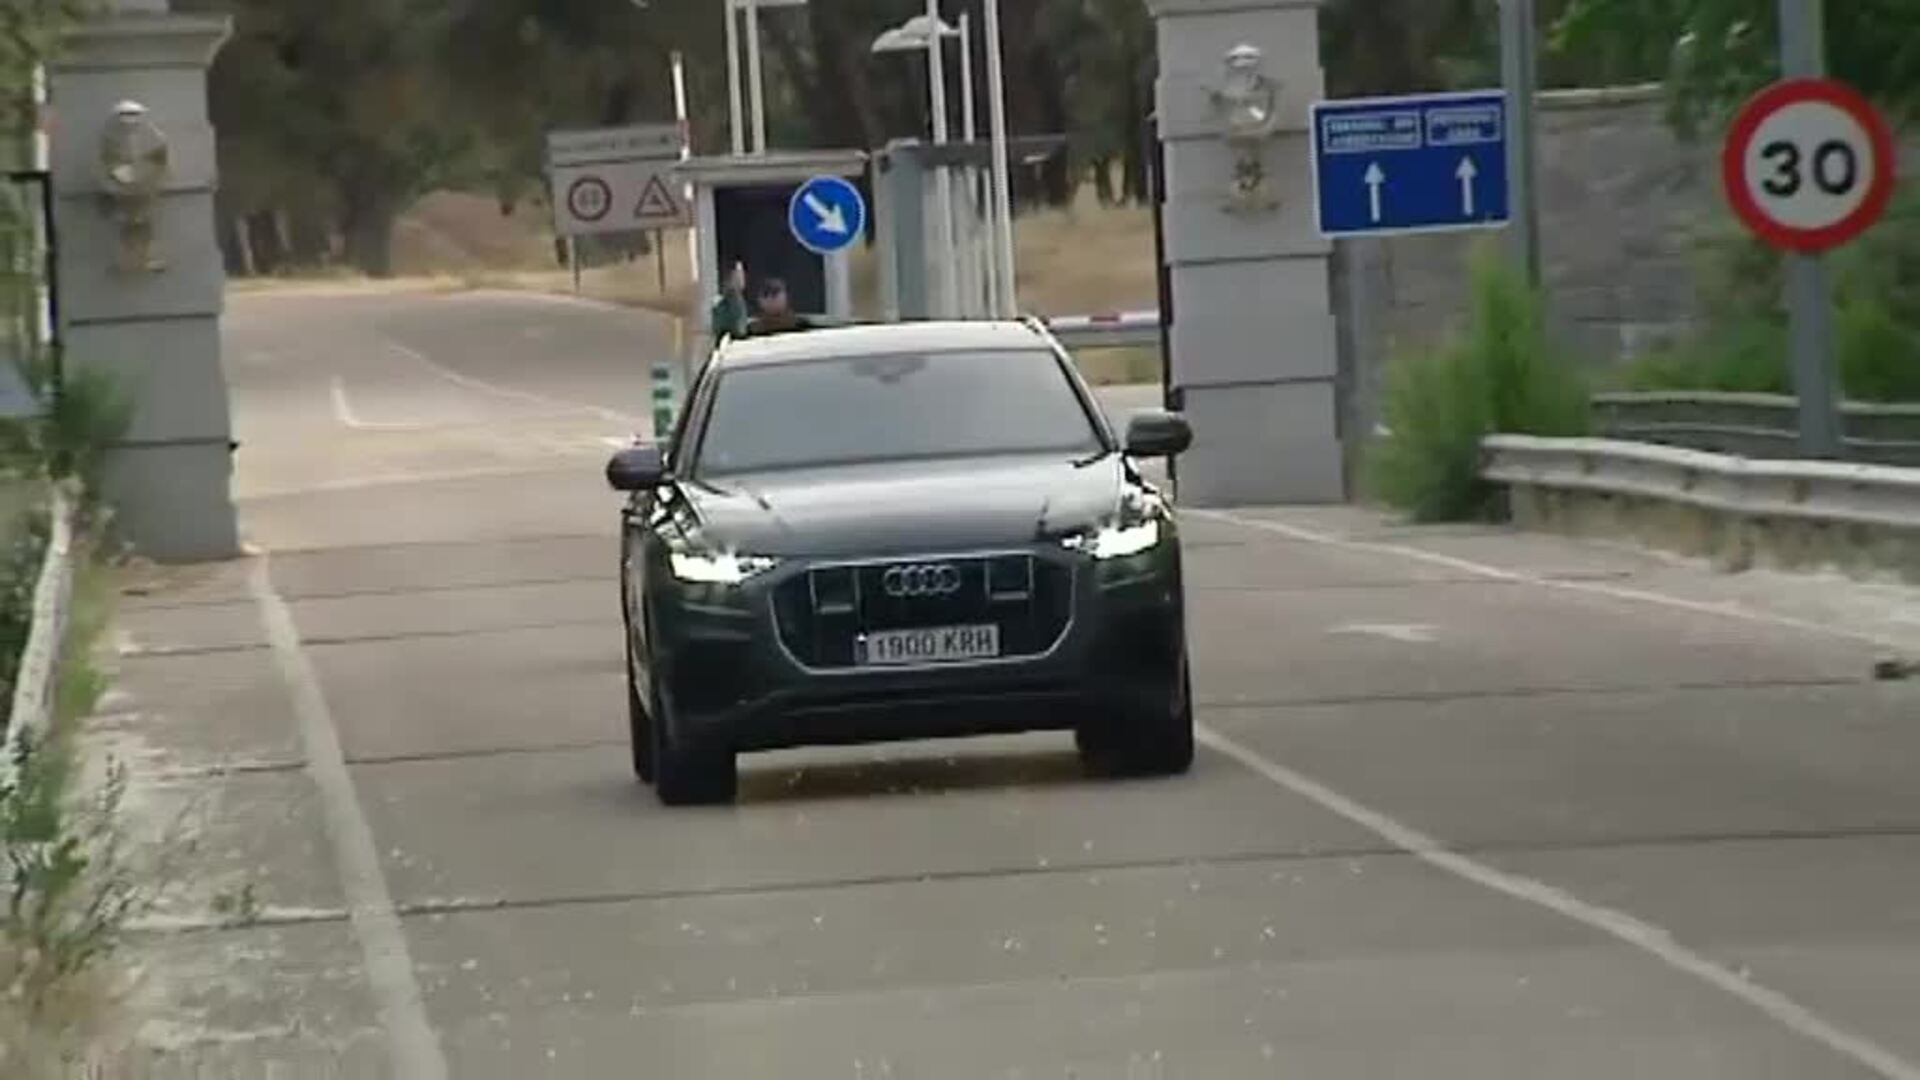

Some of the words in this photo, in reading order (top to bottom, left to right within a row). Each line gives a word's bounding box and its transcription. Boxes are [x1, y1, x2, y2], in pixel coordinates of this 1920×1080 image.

[1762, 139, 1856, 197] 30
[877, 633, 936, 660] 1900
[944, 628, 993, 653] KRH
